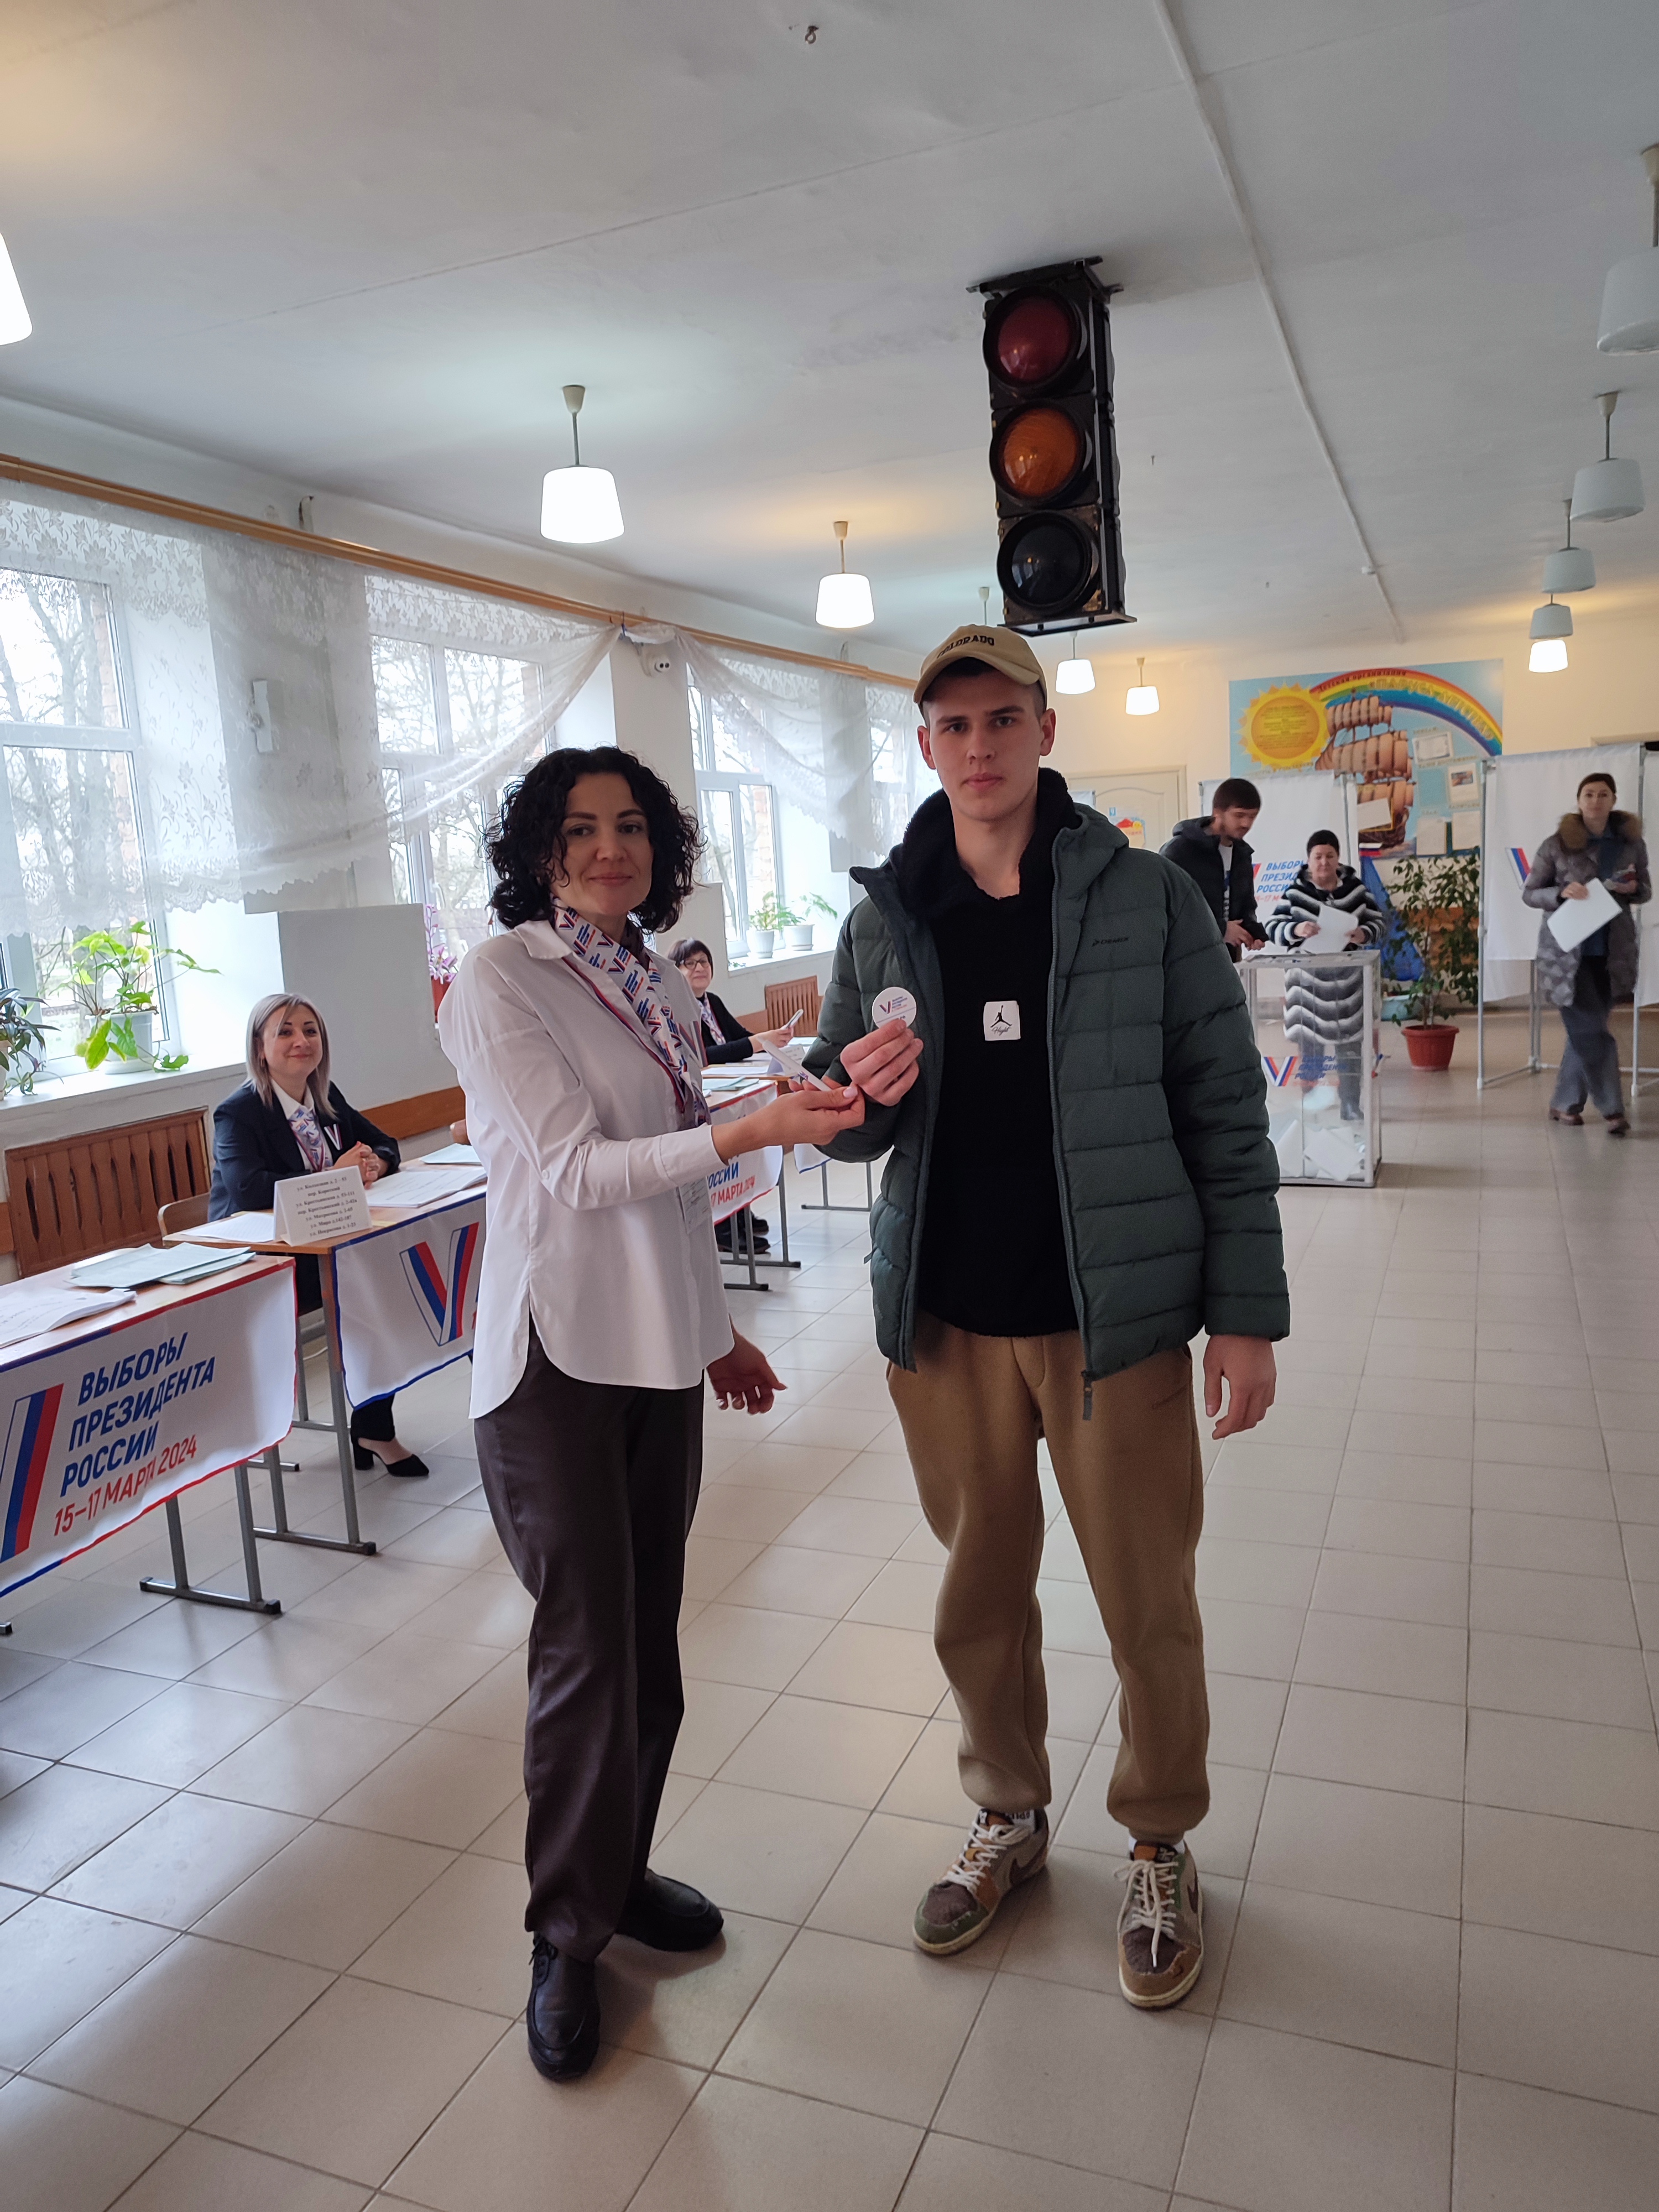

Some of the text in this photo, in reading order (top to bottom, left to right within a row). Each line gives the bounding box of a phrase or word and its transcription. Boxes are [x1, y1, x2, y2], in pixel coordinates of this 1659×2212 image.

[937, 635, 995, 658] COLORADO
[1256, 883, 1291, 893] РОССИ
[1261, 872, 1298, 882] ПРЕЗИД
[707, 1161, 739, 1190] ОССИИ
[77, 1332, 188, 1406] ВЫБОРЫ
[68, 1356, 216, 1452] ПРЕЗИДЕНТА
[60, 1420, 159, 1498] РОССИИ
[102, 1455, 156, 1510] МАРТА
[157, 1434, 197, 1475] 2024
